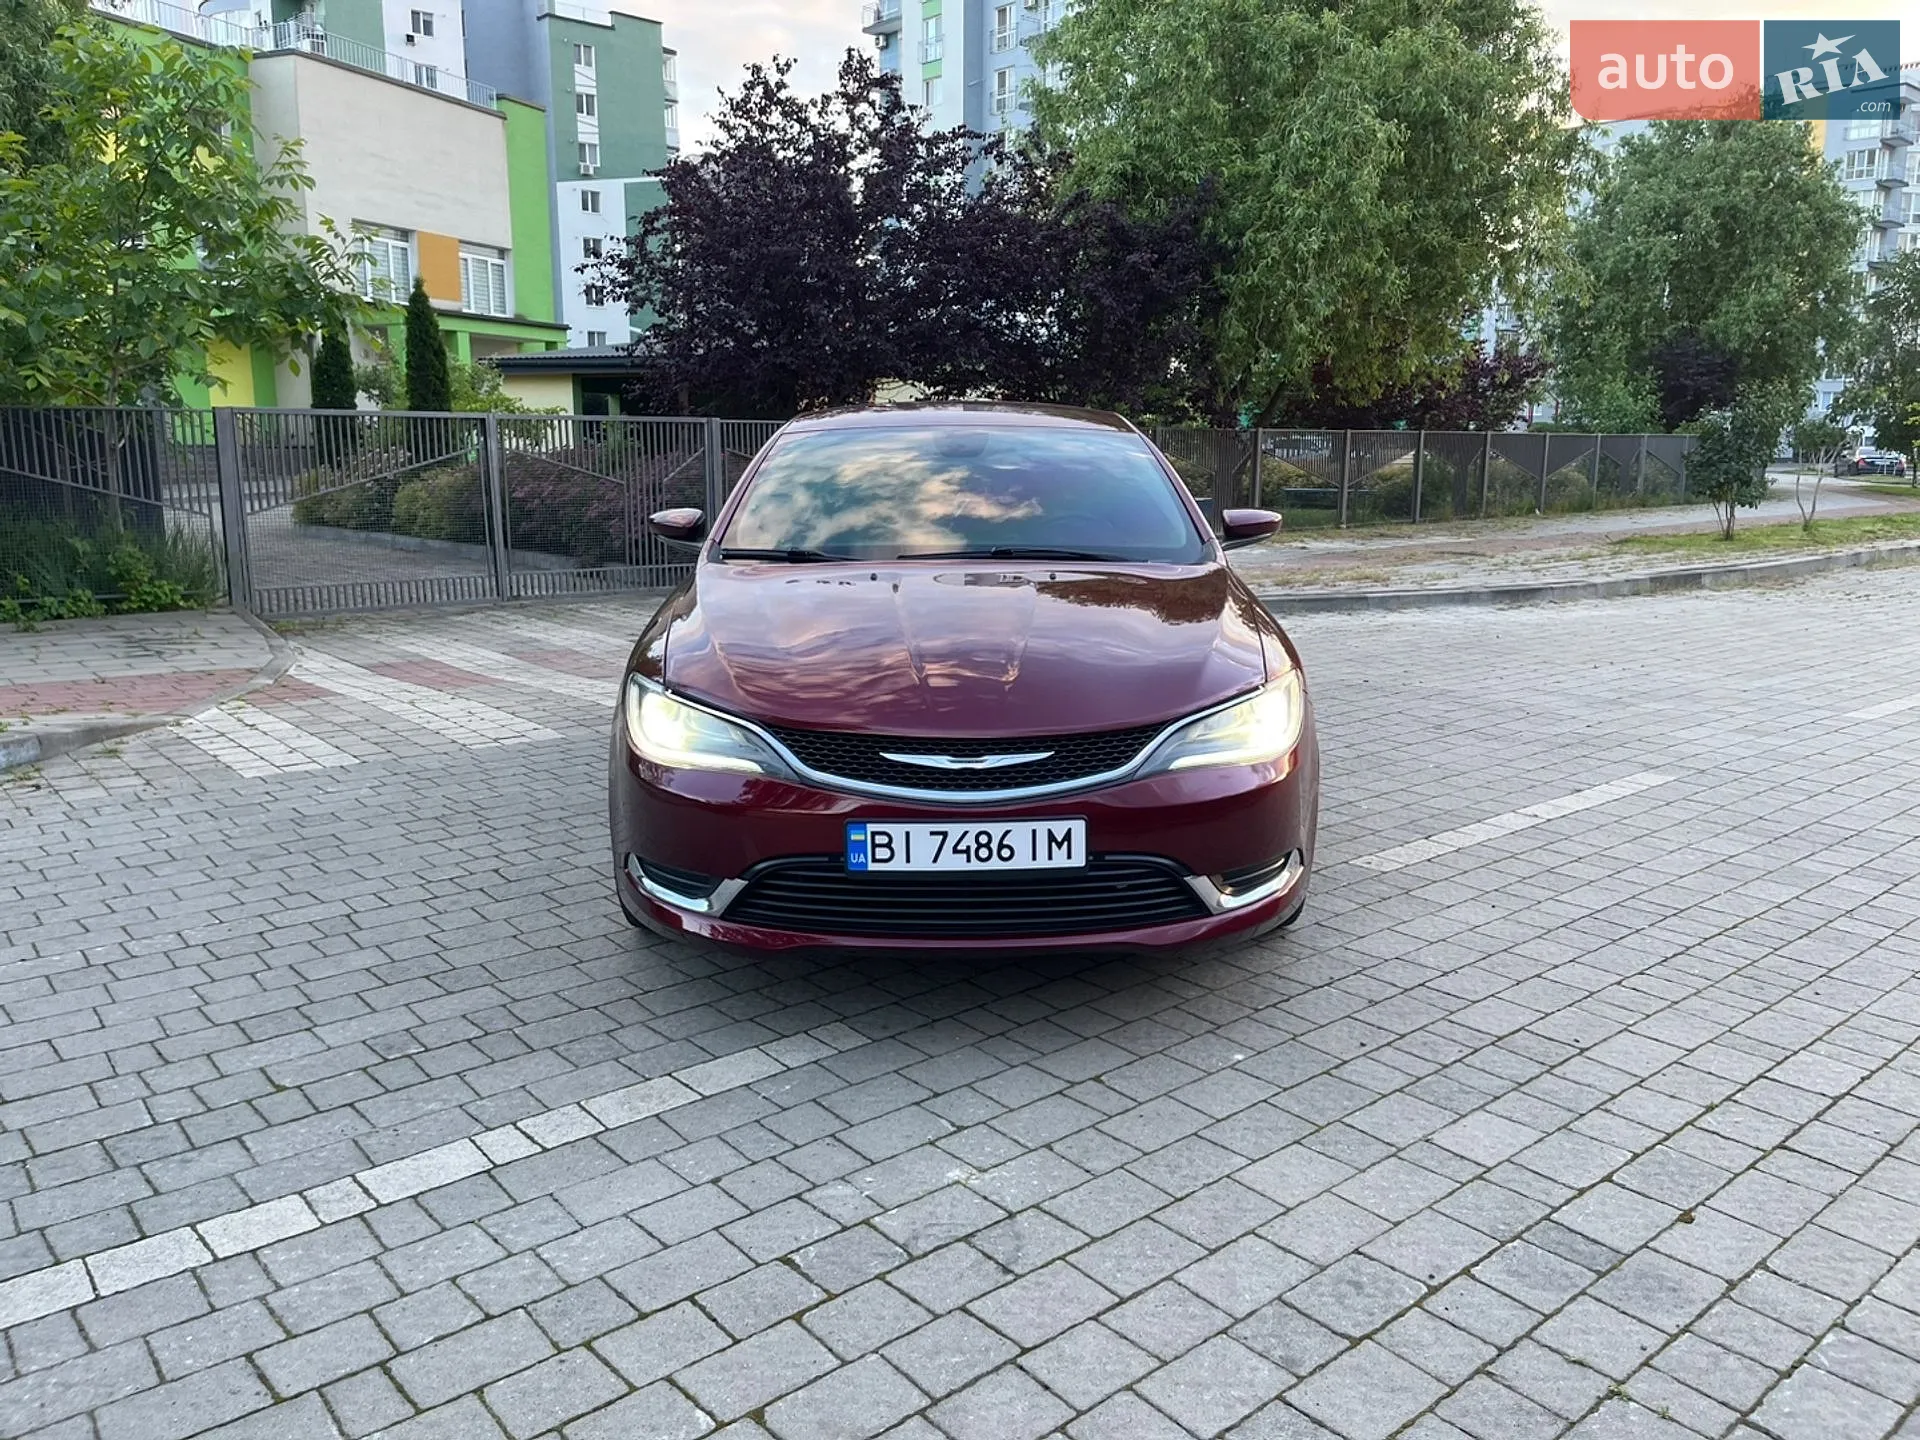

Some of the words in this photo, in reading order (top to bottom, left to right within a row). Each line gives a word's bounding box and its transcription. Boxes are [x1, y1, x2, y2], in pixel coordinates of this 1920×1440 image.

[870, 830, 911, 864] BI
[929, 829, 1015, 864] 7486
[1031, 827, 1072, 861] IM
[850, 853, 866, 863] UA
